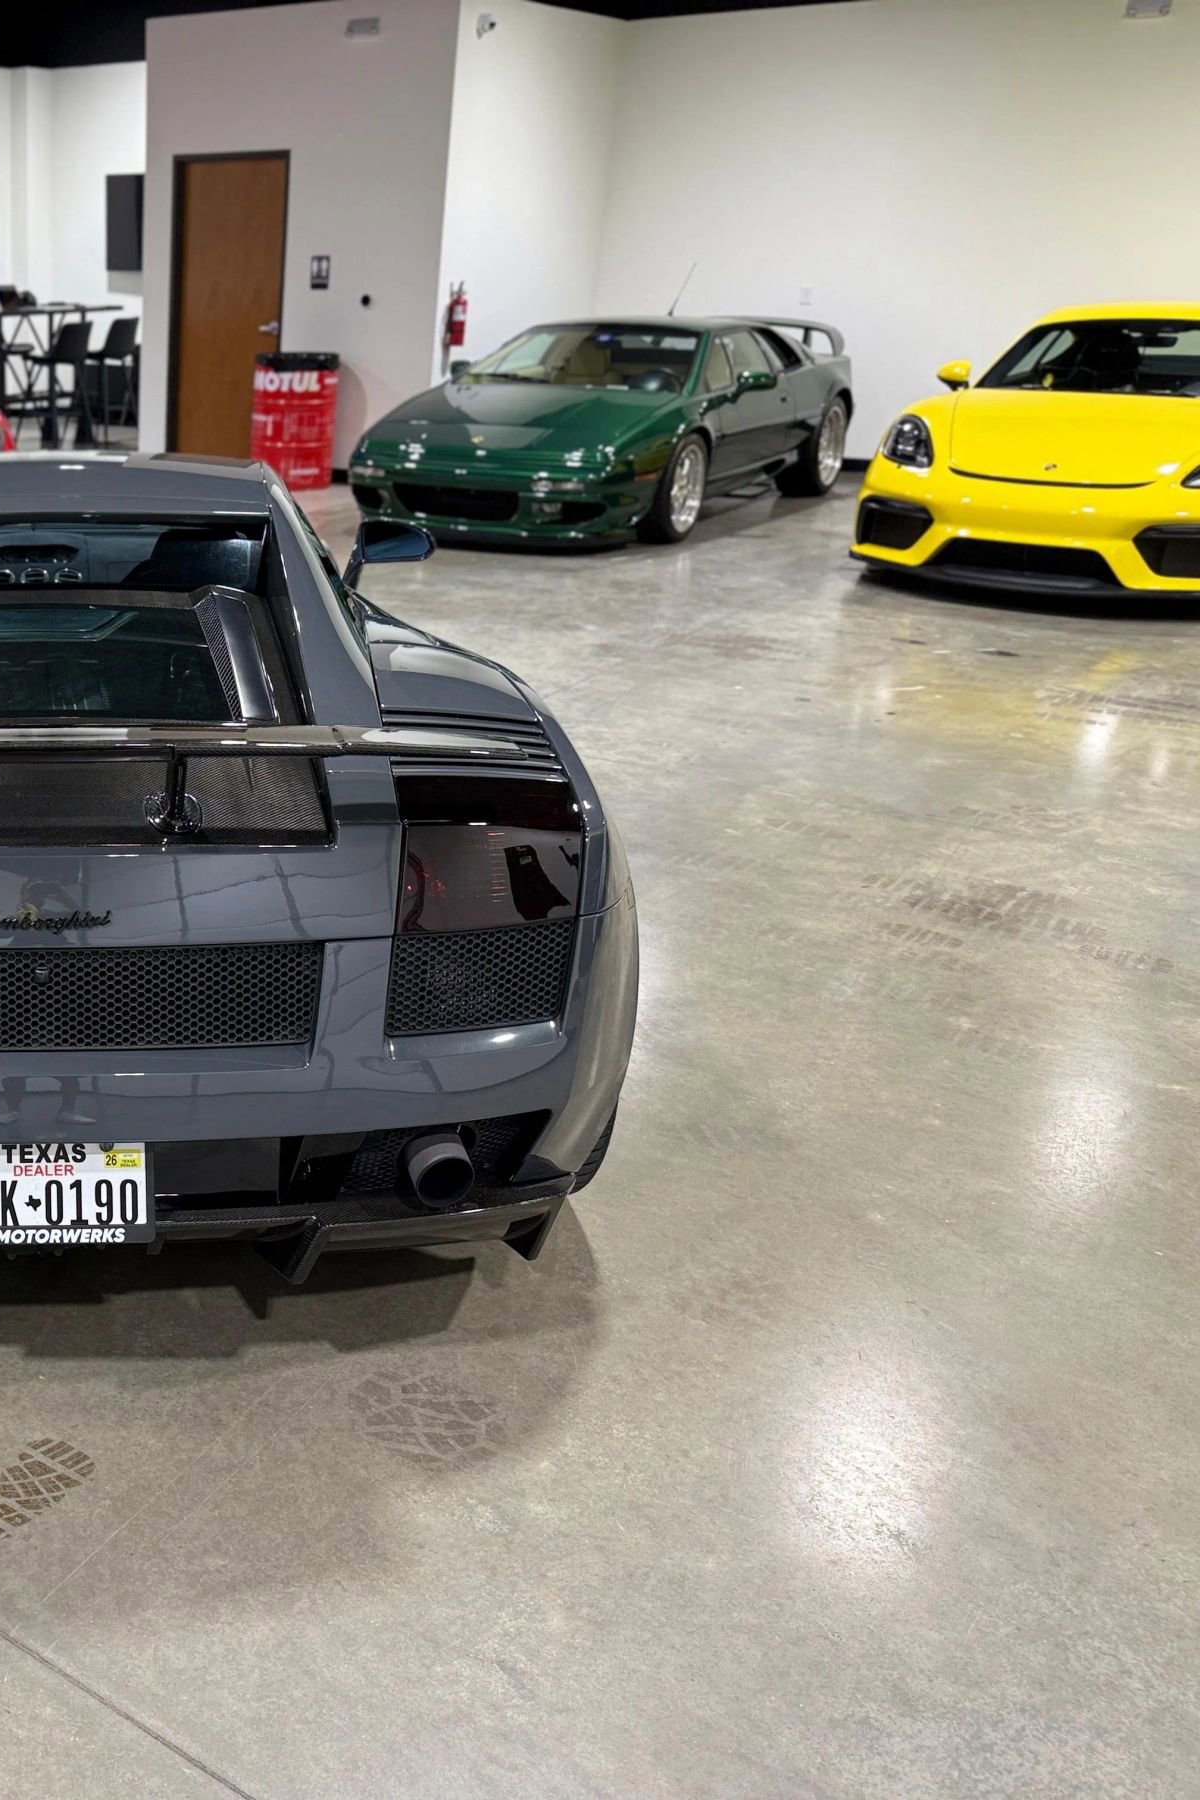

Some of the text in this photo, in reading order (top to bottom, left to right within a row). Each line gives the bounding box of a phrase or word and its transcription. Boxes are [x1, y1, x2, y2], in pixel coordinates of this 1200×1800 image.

[253, 369, 321, 393] MOTUL
[1, 1143, 87, 1164] TEXAS
[105, 1154, 118, 1167] 26
[13, 1164, 75, 1177] DEALER
